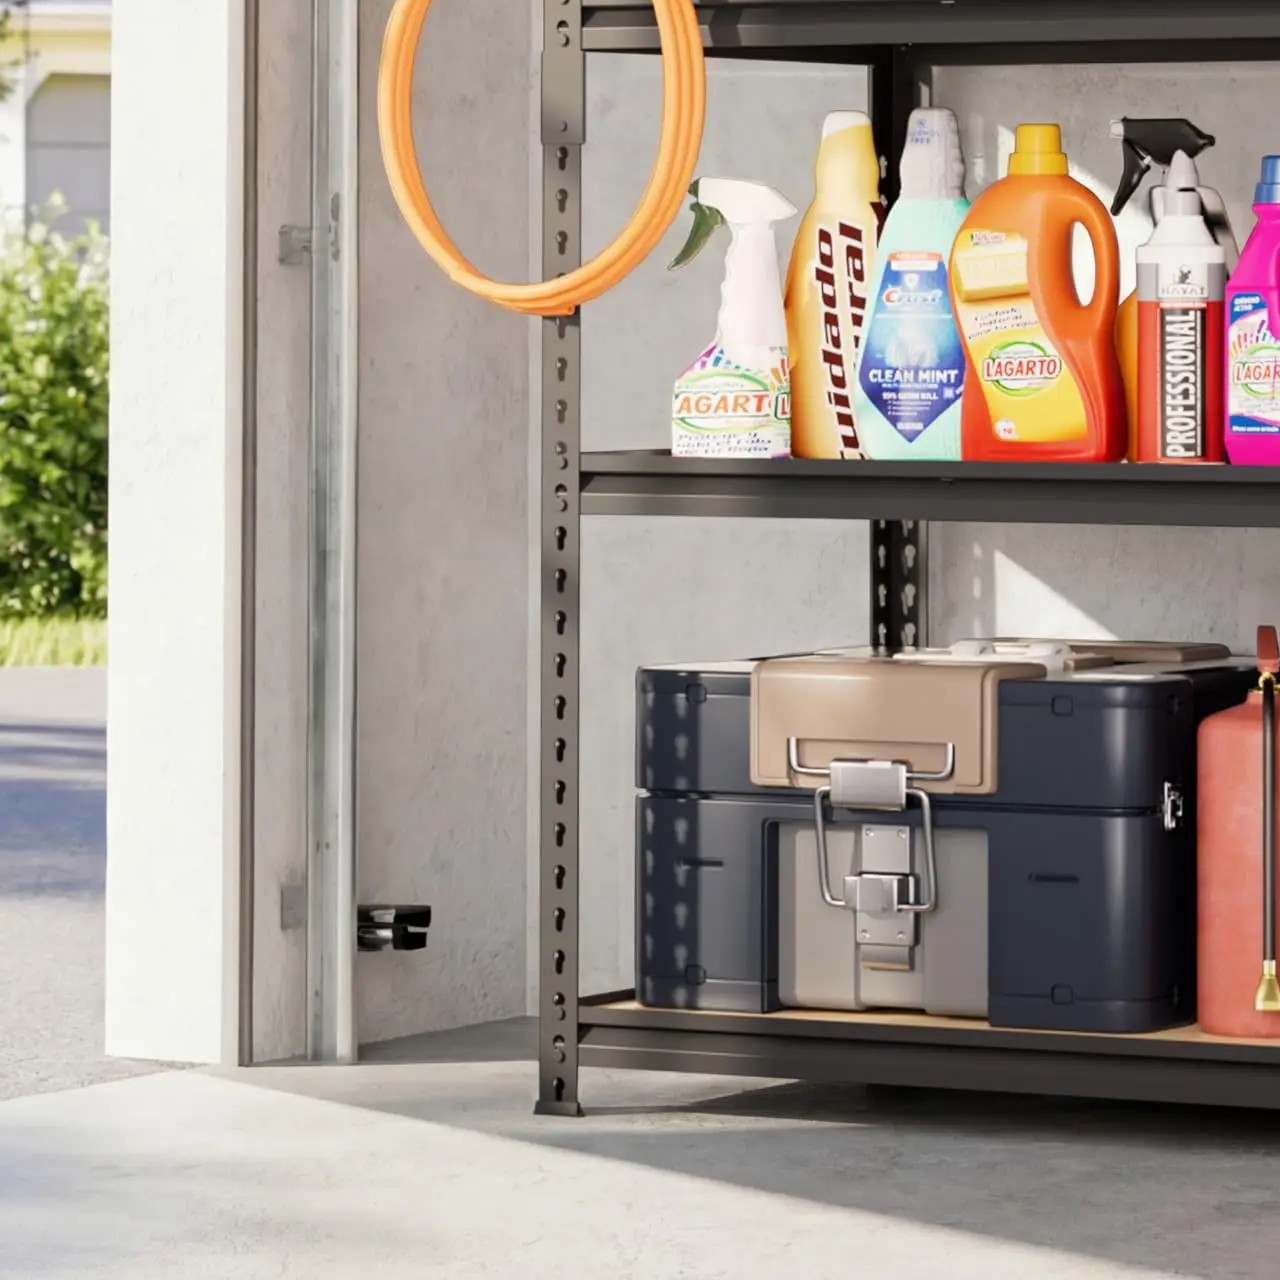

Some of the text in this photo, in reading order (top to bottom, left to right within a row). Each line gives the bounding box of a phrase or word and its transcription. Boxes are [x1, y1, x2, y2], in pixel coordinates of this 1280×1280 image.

[815, 227, 864, 460] uidado
[868, 369, 959, 384] CLEAN MINT
[985, 358, 1057, 378] LAGARTO
[1165, 309, 1197, 458] PROFESSIONAL
[677, 394, 772, 415] AGART
